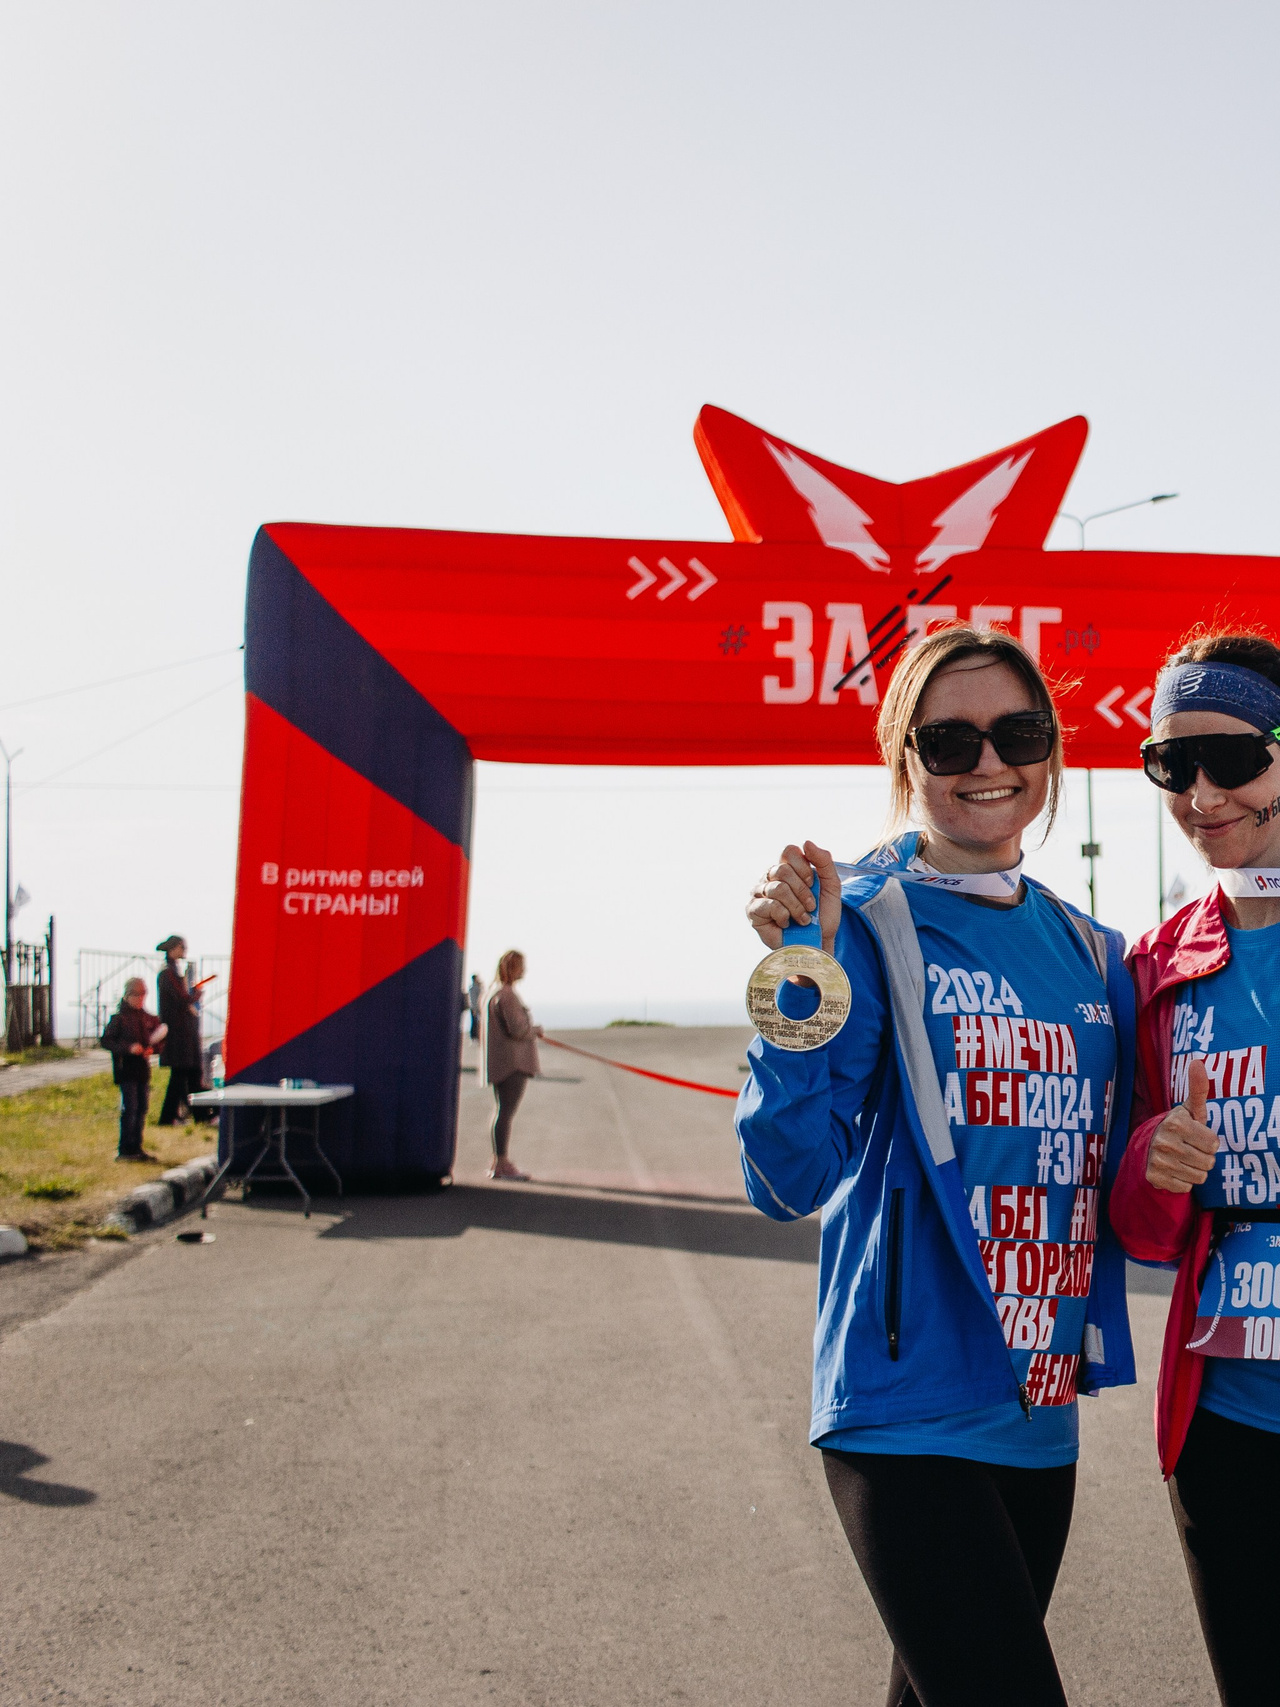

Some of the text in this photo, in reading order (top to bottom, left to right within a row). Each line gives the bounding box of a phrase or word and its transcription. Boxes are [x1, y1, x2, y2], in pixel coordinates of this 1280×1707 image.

[261, 862, 424, 889] В ритме всей
[936, 877, 965, 886] ПСБ
[283, 891, 399, 916] СТРАНЫ!
[928, 963, 1024, 1015] 2024
[954, 1015, 1078, 1075] #МЕЧТА
